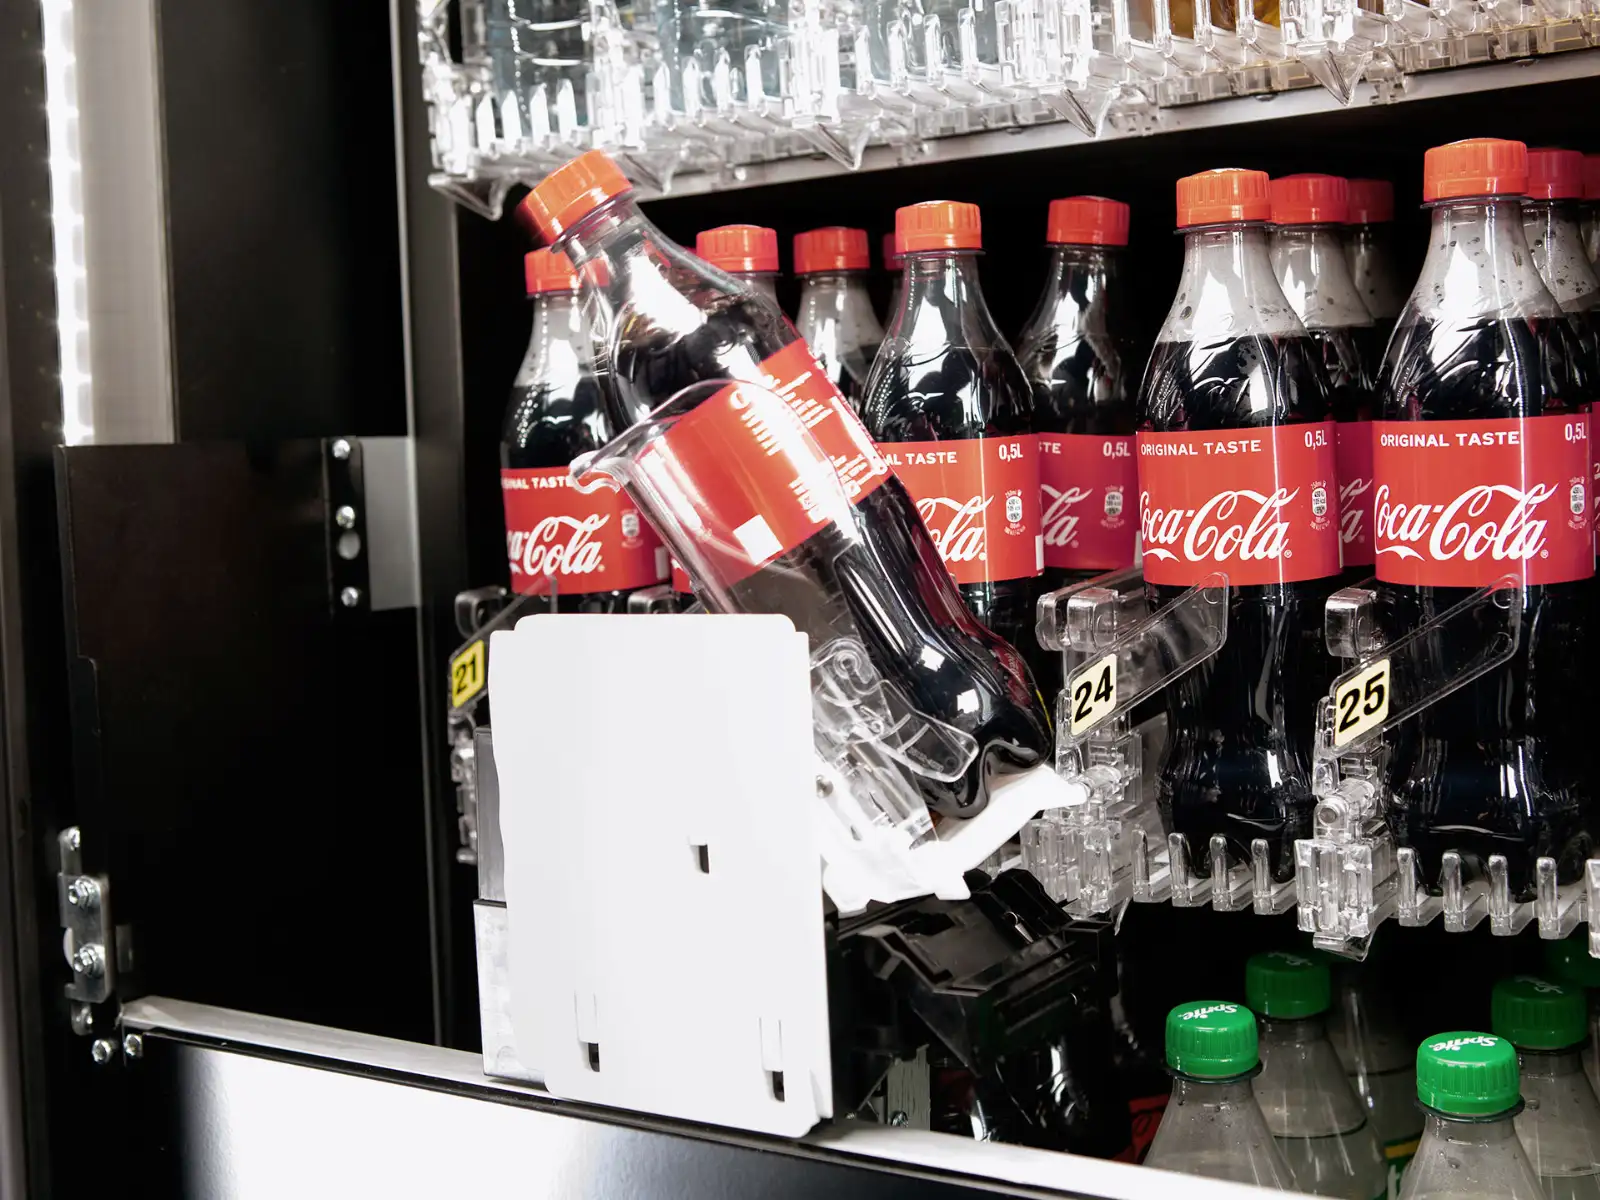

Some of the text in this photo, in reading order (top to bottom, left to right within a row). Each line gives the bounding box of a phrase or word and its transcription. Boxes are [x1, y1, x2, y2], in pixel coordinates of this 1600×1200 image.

[1304, 430, 1328, 450] 0,5L
[1380, 431, 1520, 447] ORIGINAL TASTE
[1565, 422, 1587, 444] 0,5L
[905, 451, 957, 465] TASTE
[998, 443, 1023, 462] 0,5L
[1103, 441, 1131, 459] 0,5L
[1140, 440, 1261, 456] ORIGINAL TASTE
[1139, 486, 1300, 562] Coca-Cola
[1374, 483, 1559, 562] Coca-Cola
[455, 653, 476, 695] 21
[1074, 664, 1114, 723] 24
[1338, 670, 1385, 733] 25
[1182, 1003, 1238, 1020] Sprite
